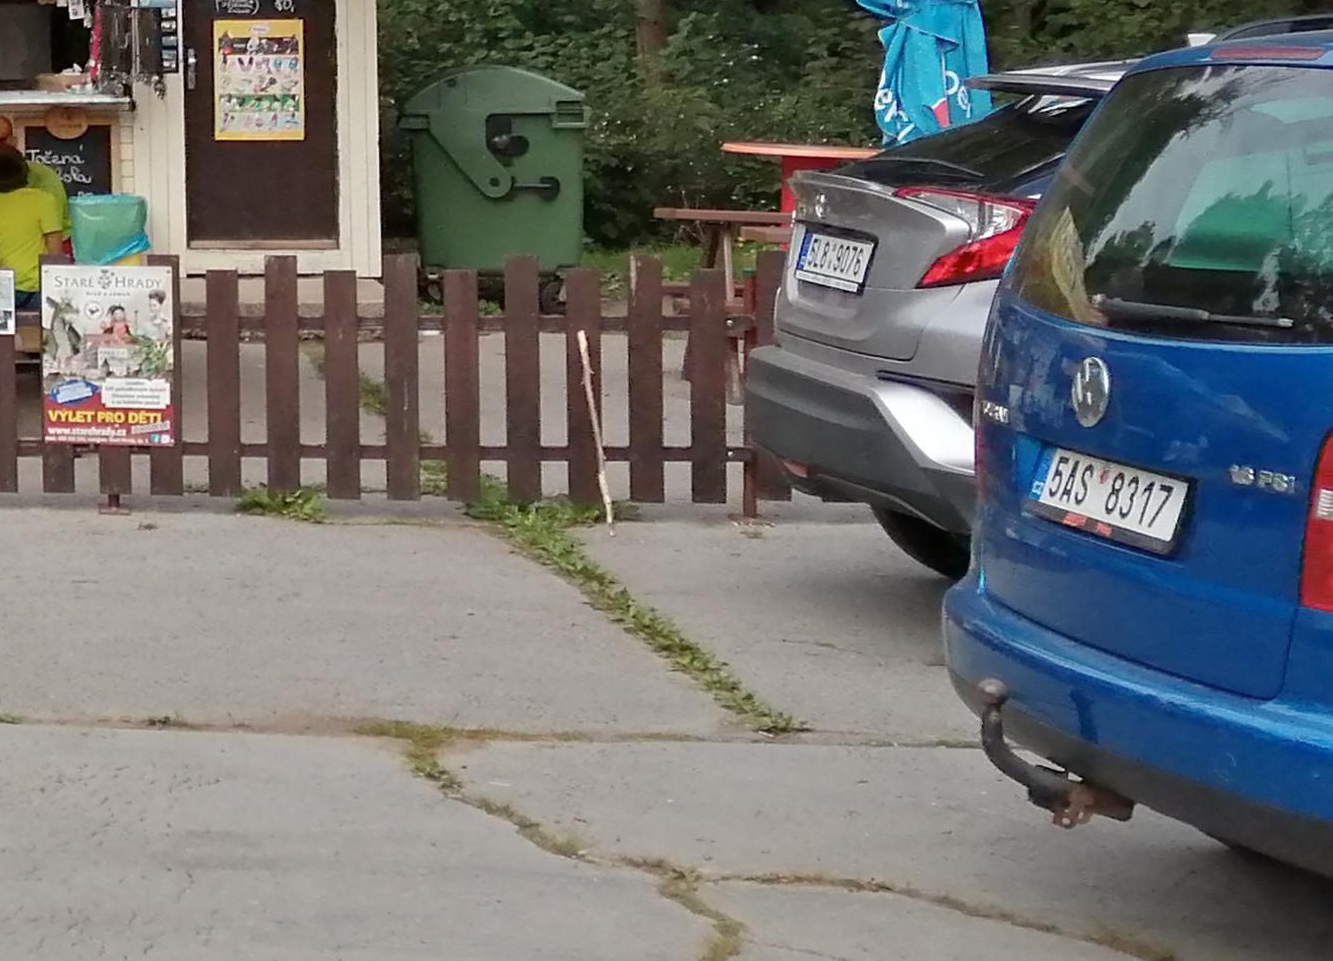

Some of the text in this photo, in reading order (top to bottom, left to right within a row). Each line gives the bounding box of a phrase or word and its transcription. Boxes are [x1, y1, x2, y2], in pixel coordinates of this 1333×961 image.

[833, 243, 864, 277] 9076
[47, 407, 163, 425] VÝLET PRO DĚTI
[1048, 456, 1095, 506] 5AS
[1104, 472, 1175, 528] 8317
